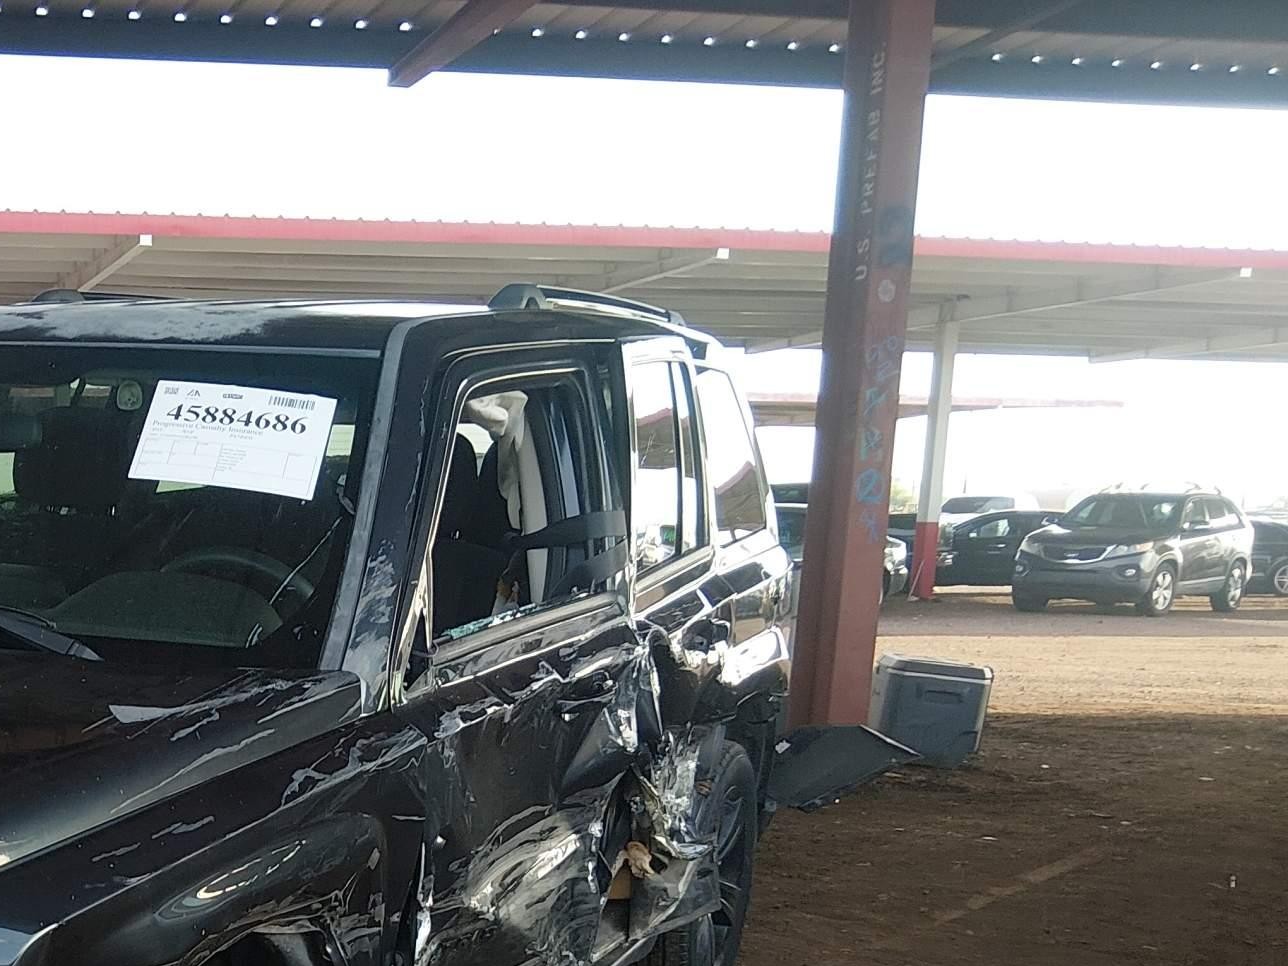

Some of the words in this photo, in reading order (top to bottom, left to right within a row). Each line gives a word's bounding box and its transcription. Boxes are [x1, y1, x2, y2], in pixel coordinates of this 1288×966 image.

[869, 41, 888, 95] INC.
[860, 108, 881, 215] PREFAB
[855, 229, 872, 281] U.S.
[167, 403, 309, 435] 45884686
